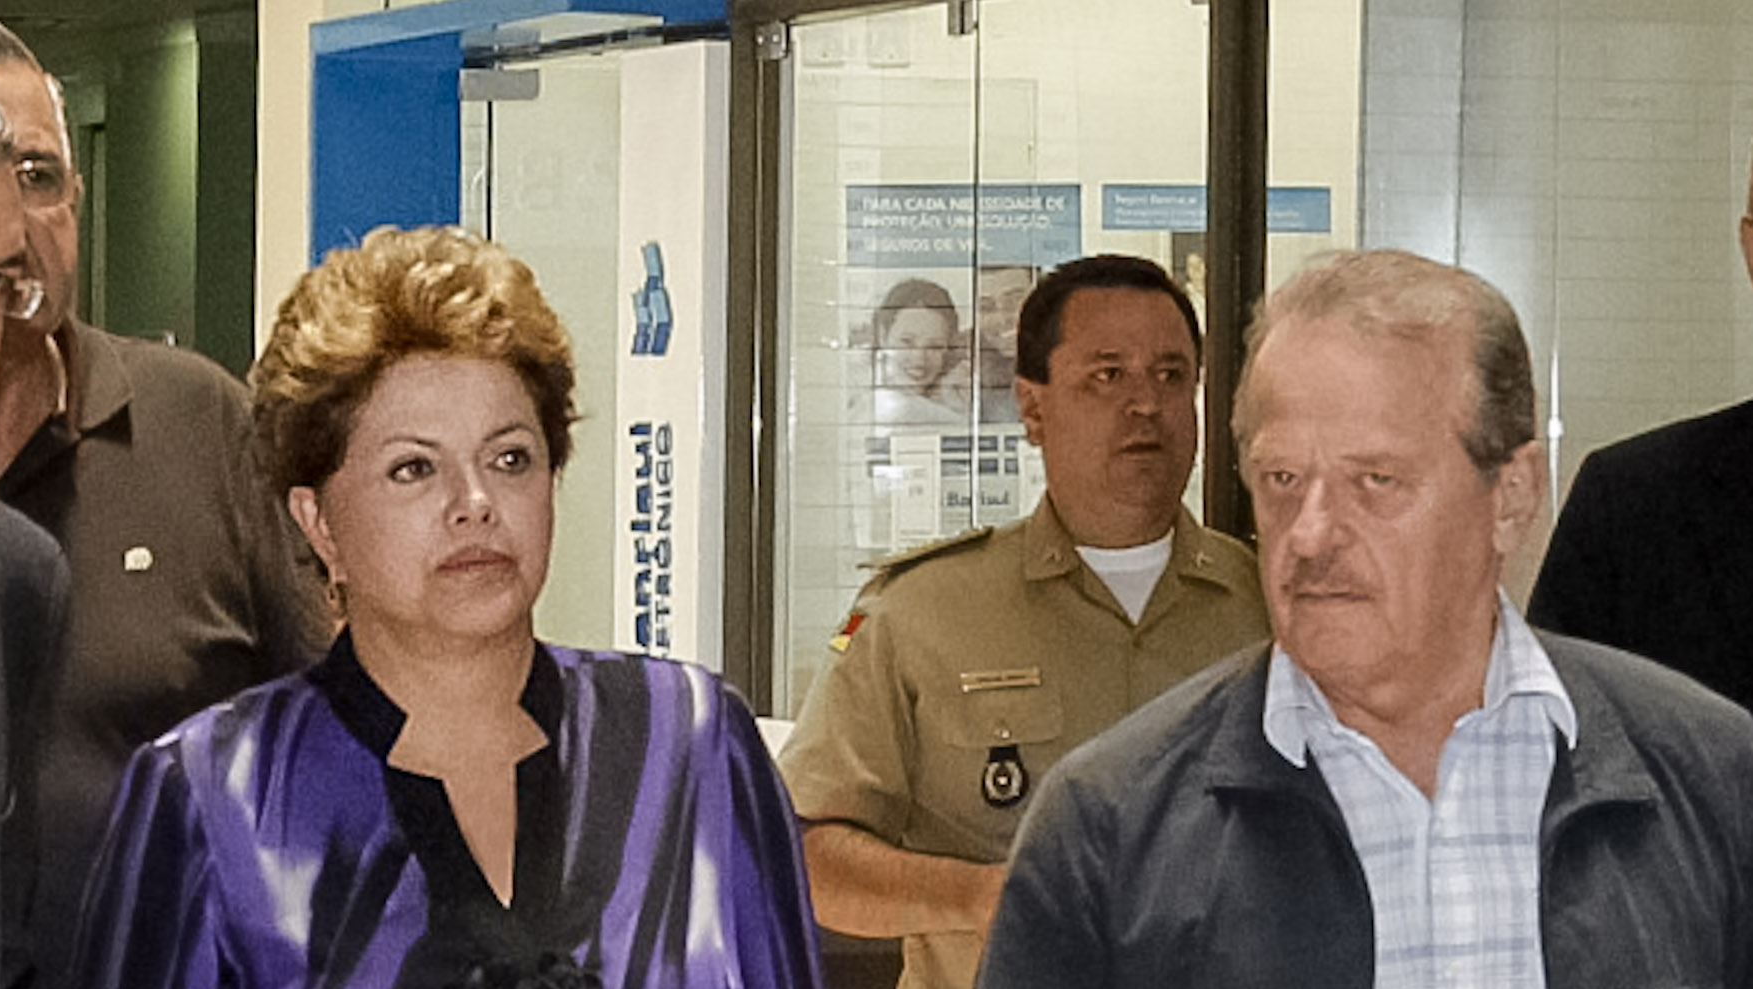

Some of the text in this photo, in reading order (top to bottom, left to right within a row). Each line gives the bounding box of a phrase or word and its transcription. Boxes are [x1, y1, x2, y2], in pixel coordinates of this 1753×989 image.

[905, 197, 946, 211] CADA
[1046, 197, 1065, 211] DE
[933, 237, 952, 251] DE
